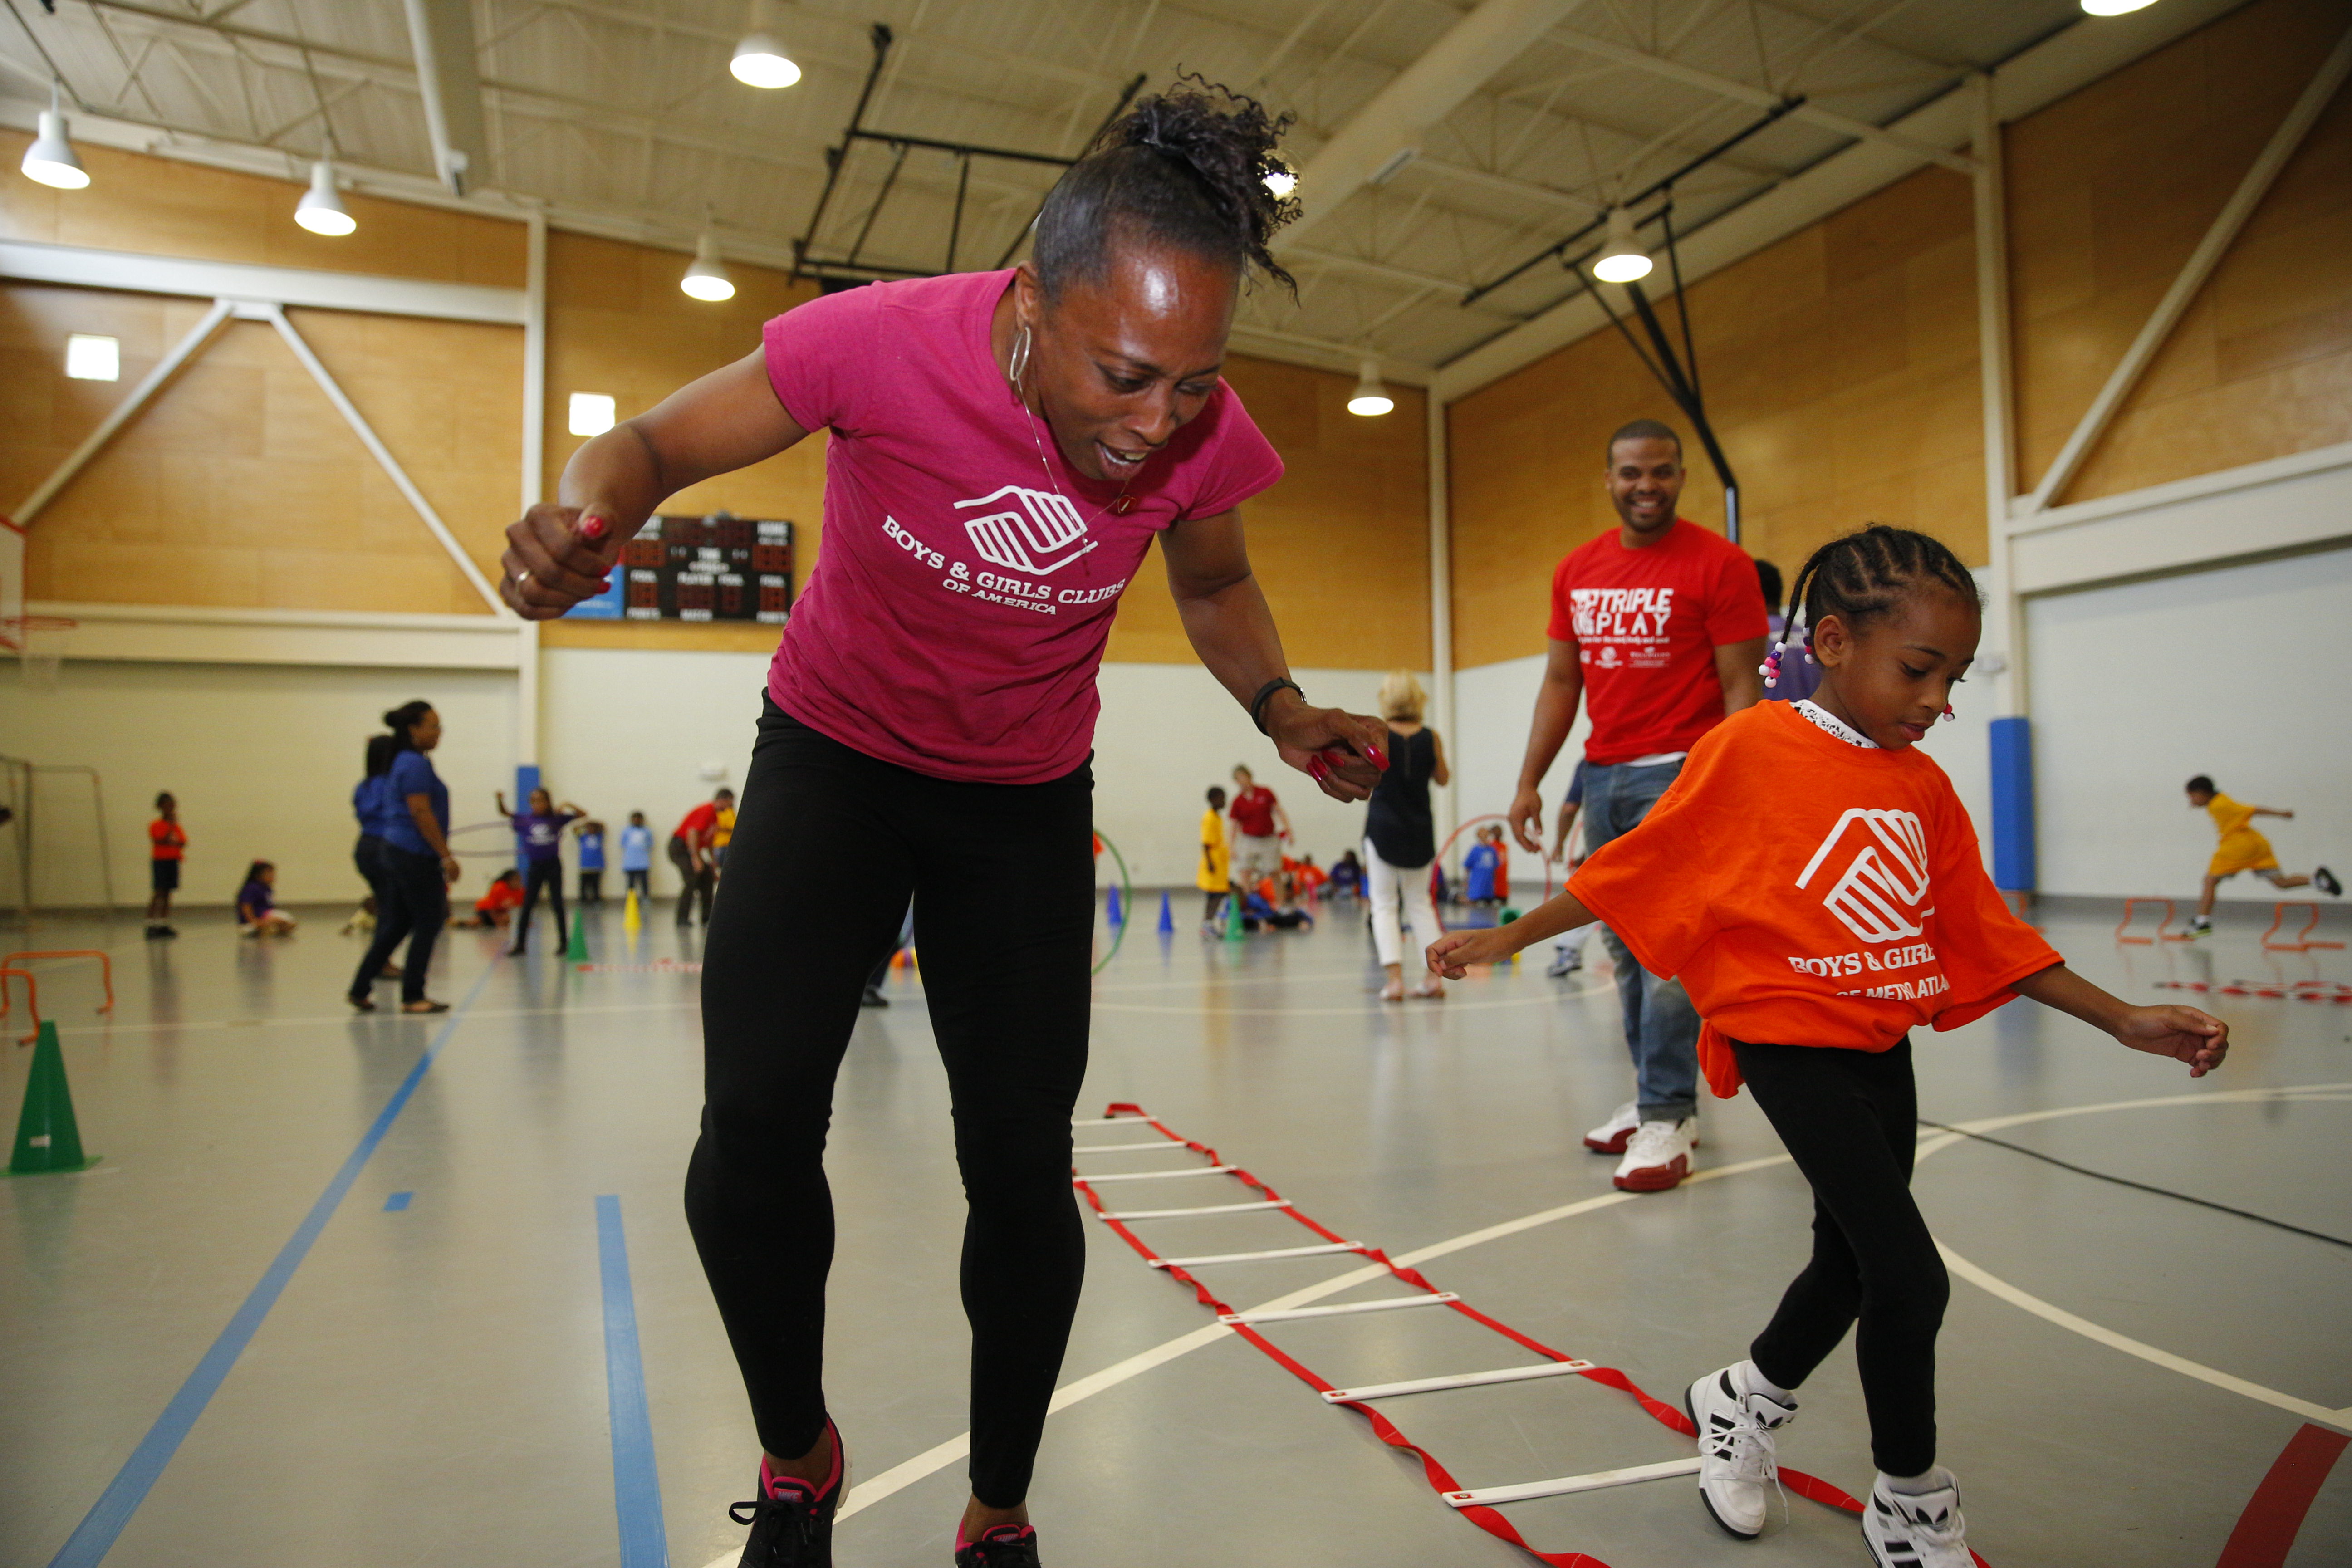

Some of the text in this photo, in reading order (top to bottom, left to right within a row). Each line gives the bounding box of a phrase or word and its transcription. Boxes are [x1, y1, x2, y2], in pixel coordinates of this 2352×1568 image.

[882, 515, 1126, 604] BOYS & GIRLS CLUBS
[942, 579, 1057, 615] OF AMERICA
[1600, 588, 1674, 613] TRIPLE
[1596, 612, 1671, 636] PLAY
[1788, 952, 1862, 977] BOYS
[1864, 952, 1884, 971] &
